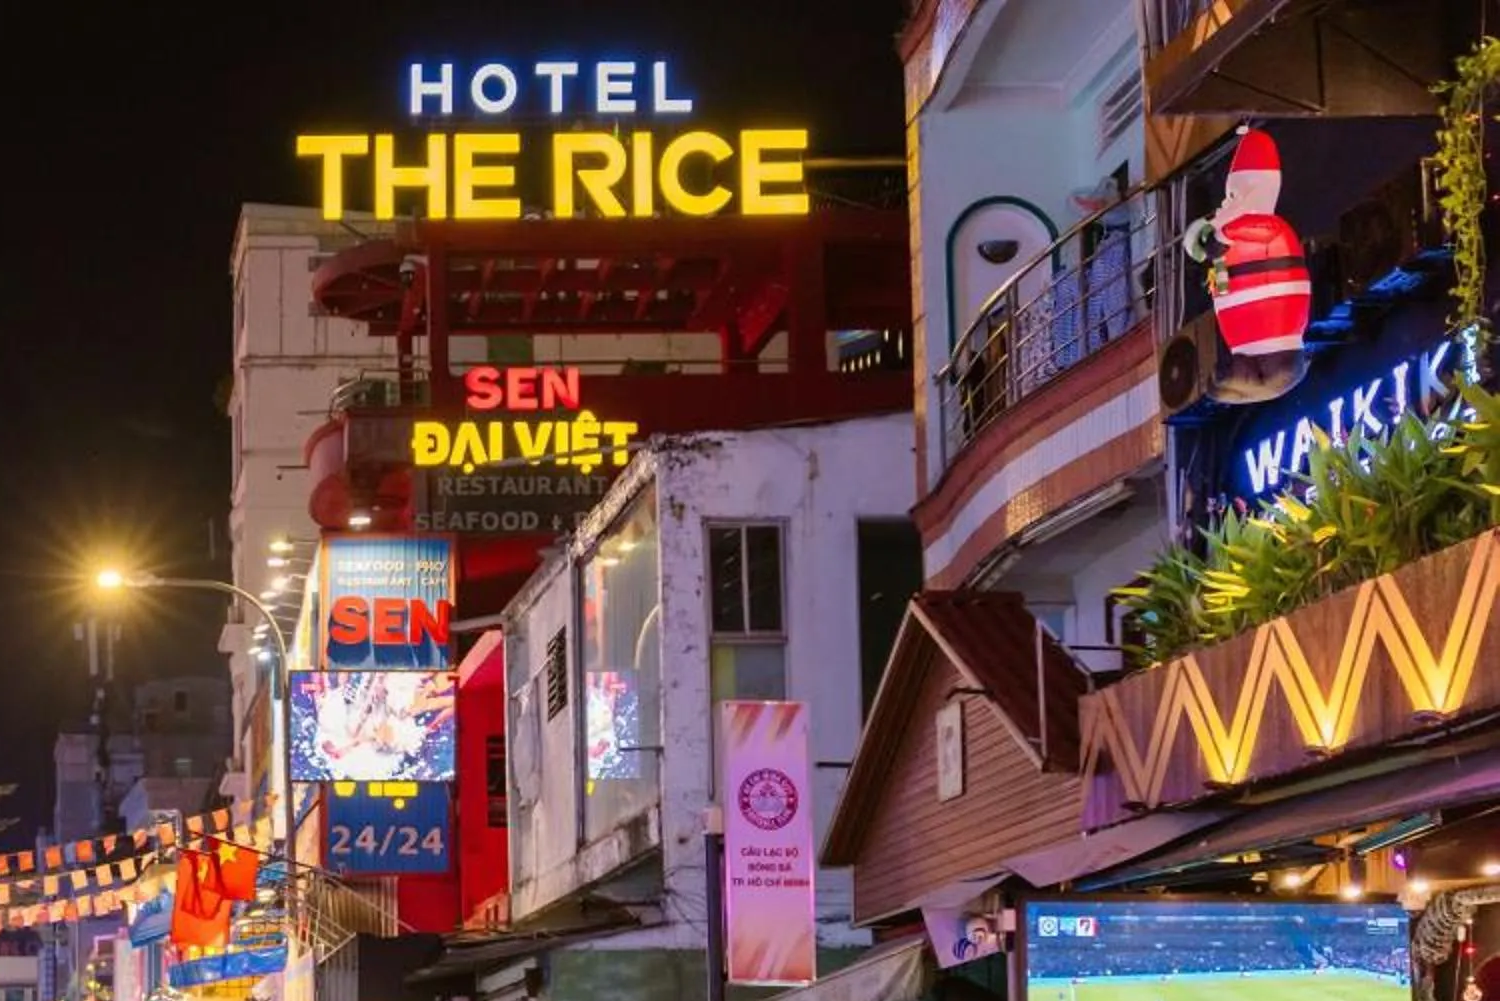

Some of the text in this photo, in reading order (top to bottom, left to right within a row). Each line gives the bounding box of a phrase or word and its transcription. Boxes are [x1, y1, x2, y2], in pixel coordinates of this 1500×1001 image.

[409, 60, 693, 116] HOTEL
[296, 129, 810, 221] THE RICE
[464, 365, 580, 411] SEN
[411, 409, 638, 475] ĐẠI VIỆT
[437, 475, 608, 496] RESTAURANT
[415, 510, 539, 532] SEAFOOD
[329, 595, 451, 645] SEN
[330, 824, 445, 857] 24/24
